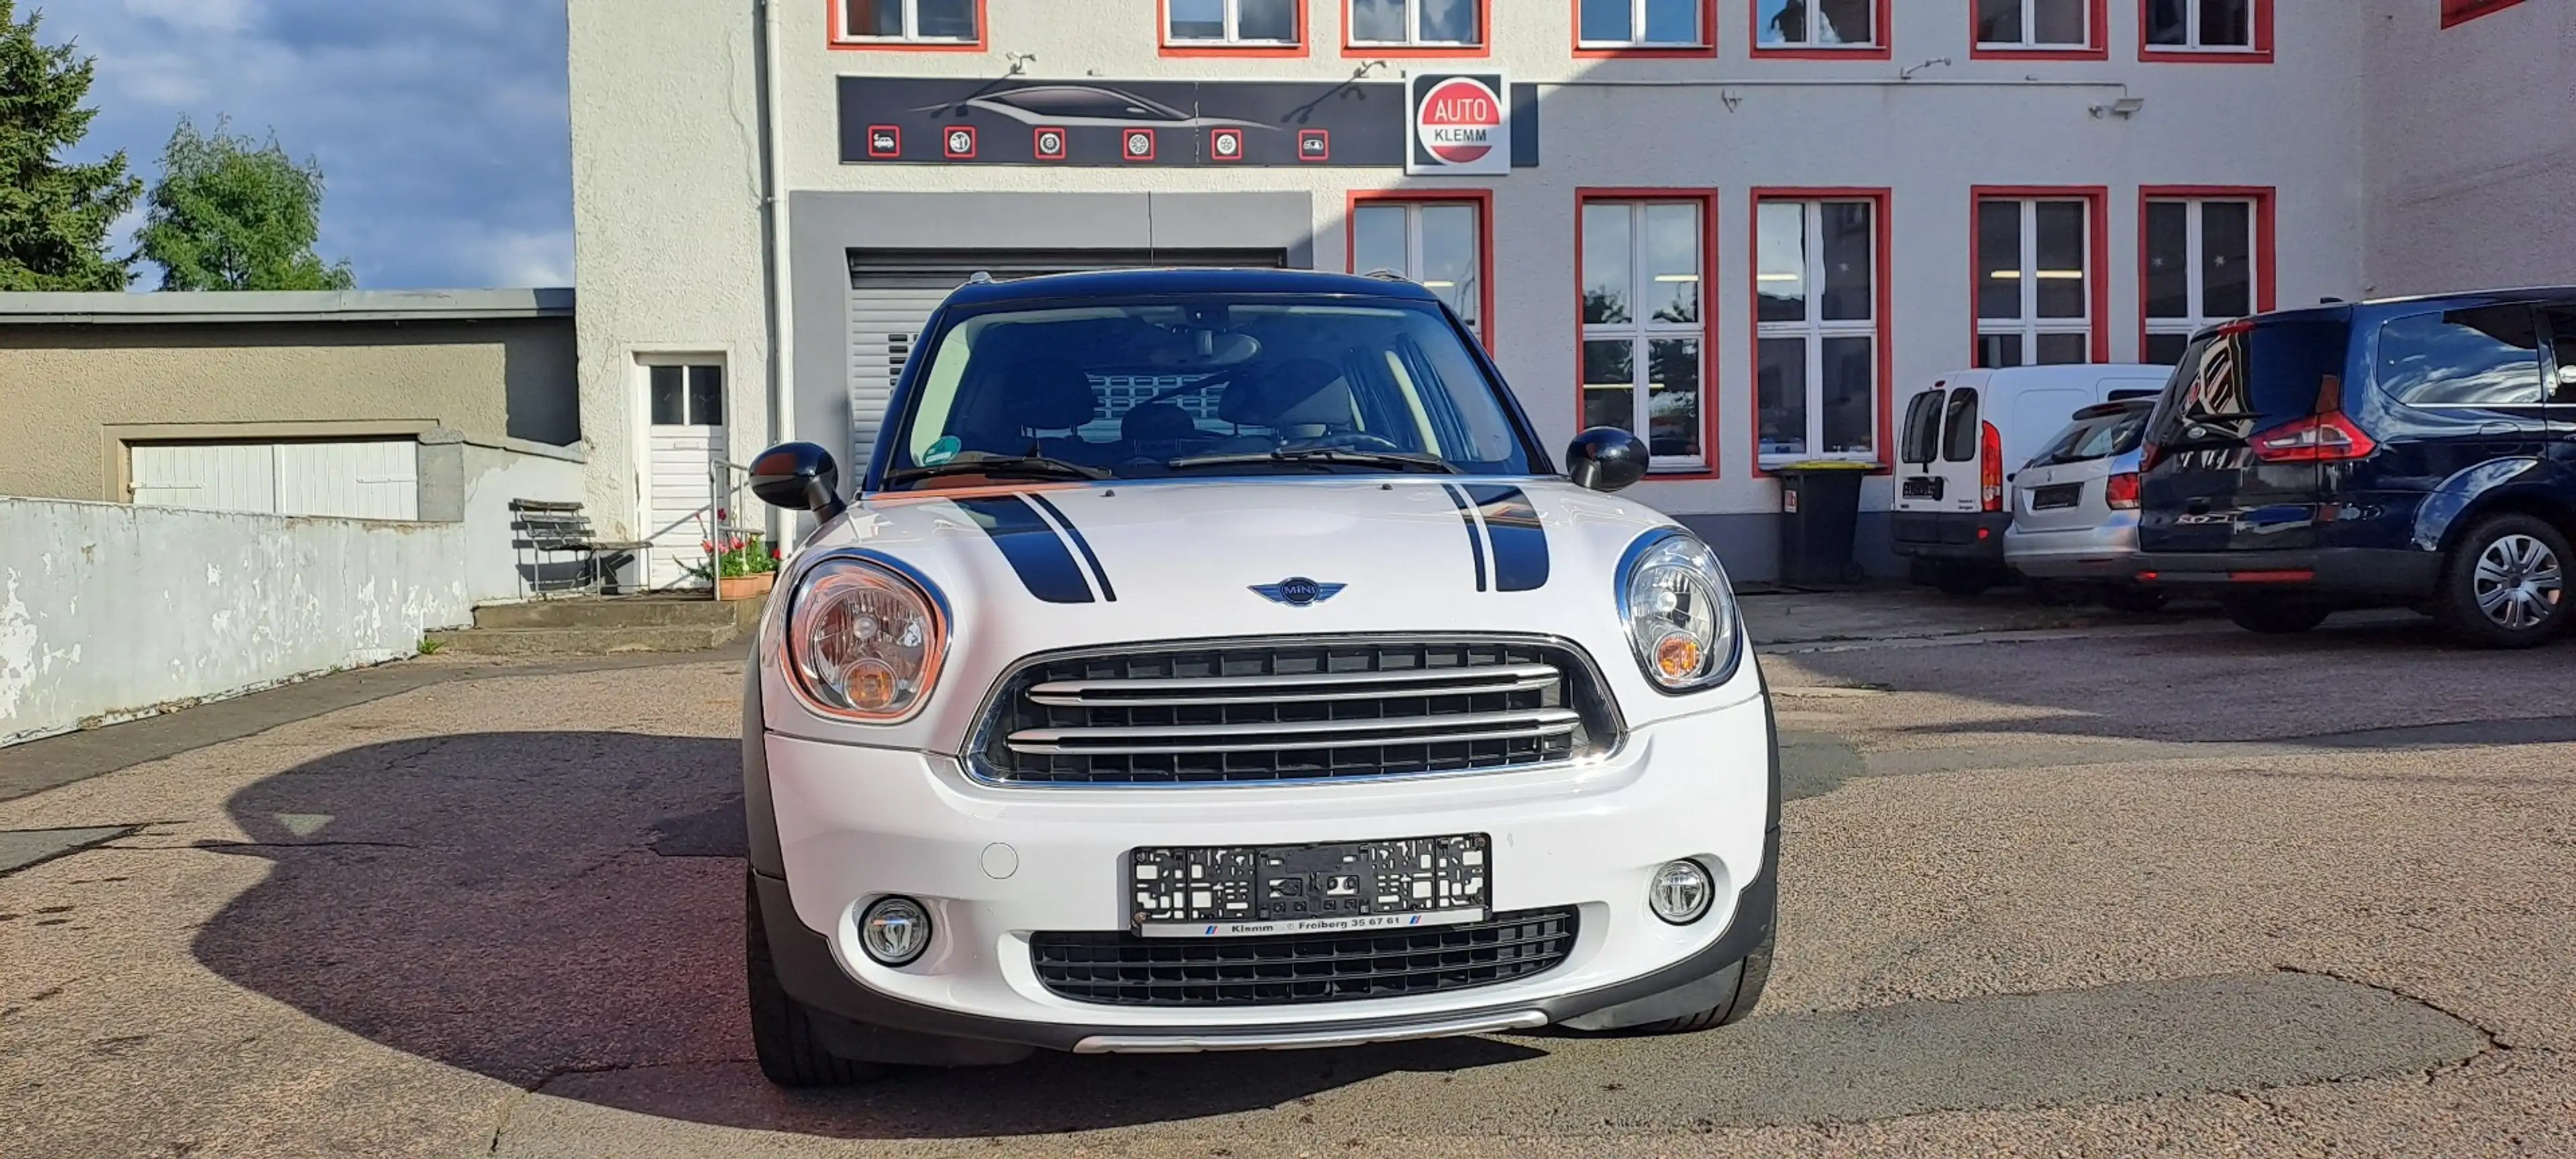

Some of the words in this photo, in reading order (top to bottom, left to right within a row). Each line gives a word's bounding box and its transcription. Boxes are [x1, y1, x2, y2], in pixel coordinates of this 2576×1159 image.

[1434, 99, 1487, 121] AUTO
[1434, 129, 1487, 142] KLEMM
[1284, 585, 1316, 595] MINI
[1232, 925, 1273, 933] Klemm
[1298, 920, 1348, 929] Freiberg
[1351, 919, 1365, 927] 35
[1369, 918, 1383, 926] 67
